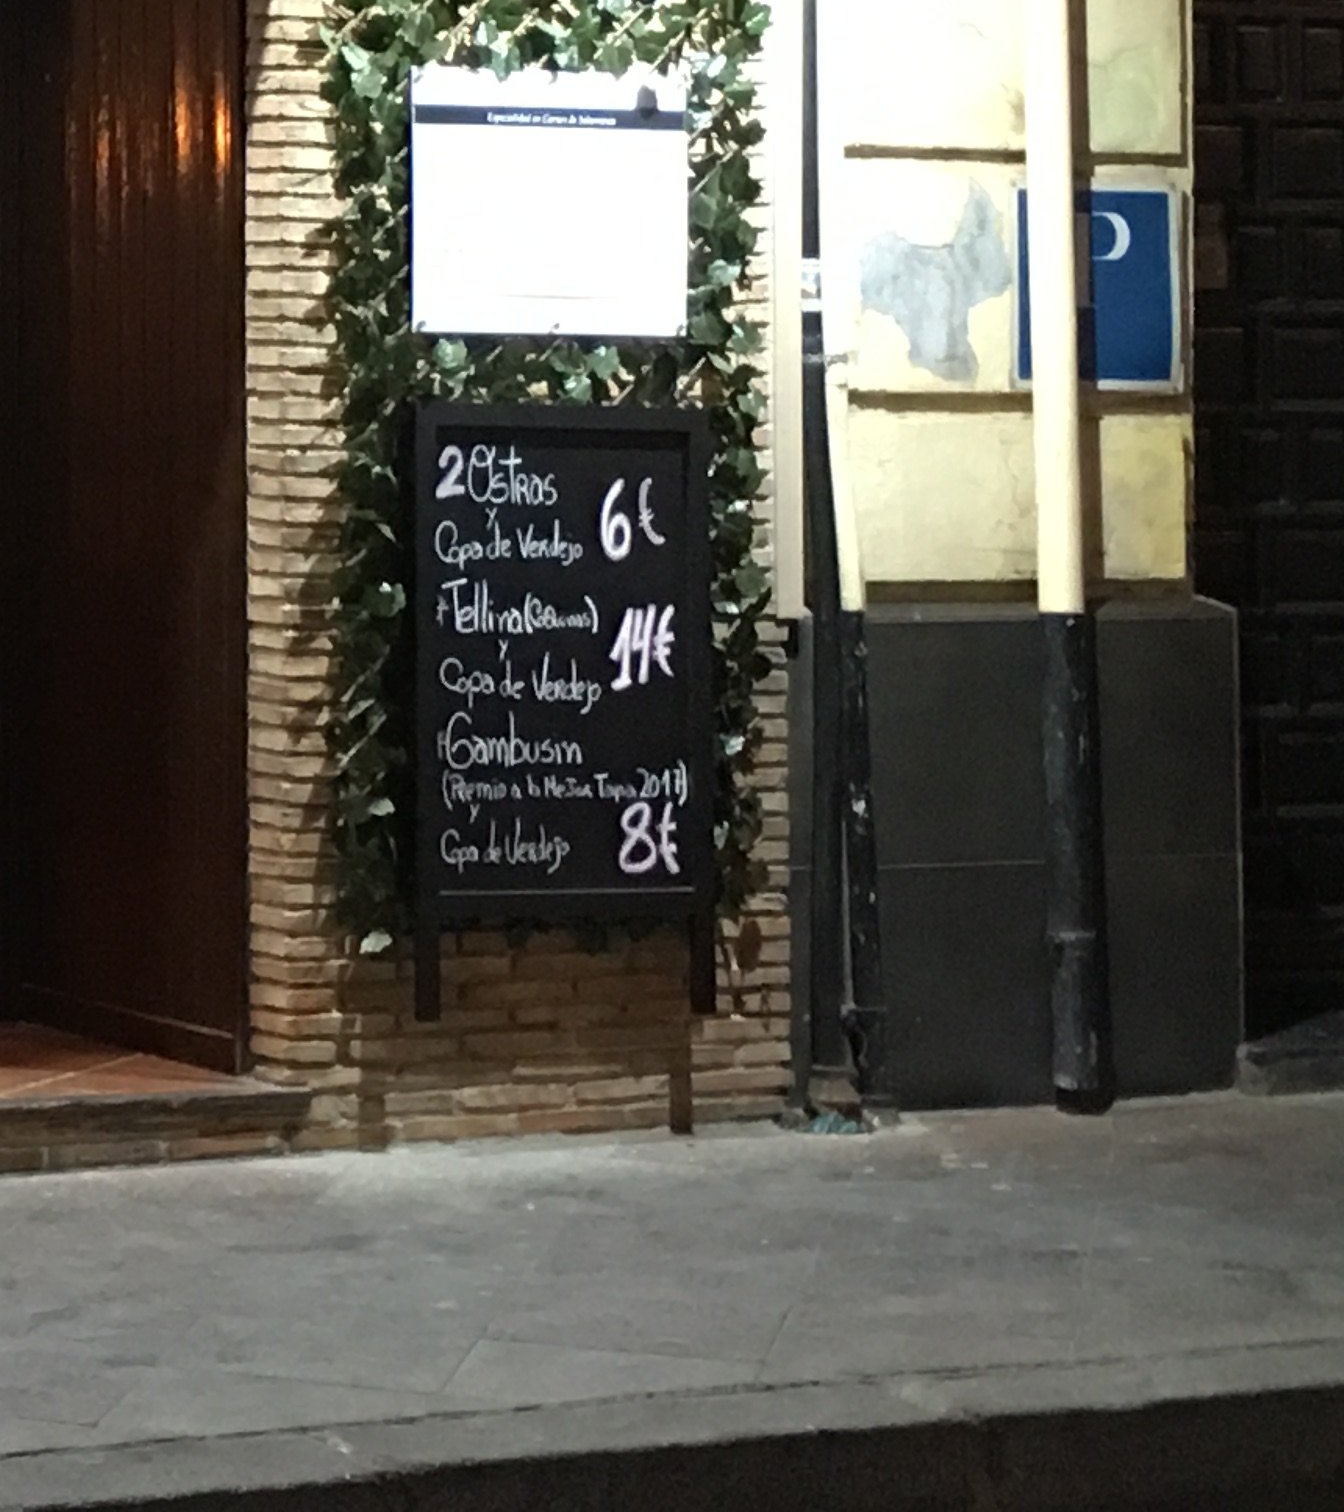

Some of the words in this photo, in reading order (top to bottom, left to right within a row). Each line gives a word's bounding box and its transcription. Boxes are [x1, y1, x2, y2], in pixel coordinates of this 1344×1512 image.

[435, 520, 483, 570] Copa
[486, 522, 512, 560] de
[609, 604, 674, 691] 14€
[440, 658, 495, 708] Copa
[500, 660, 525, 700] de
[441, 829, 478, 873] Copa
[483, 819, 501, 864] de
[619, 801, 680, 874] 8€
